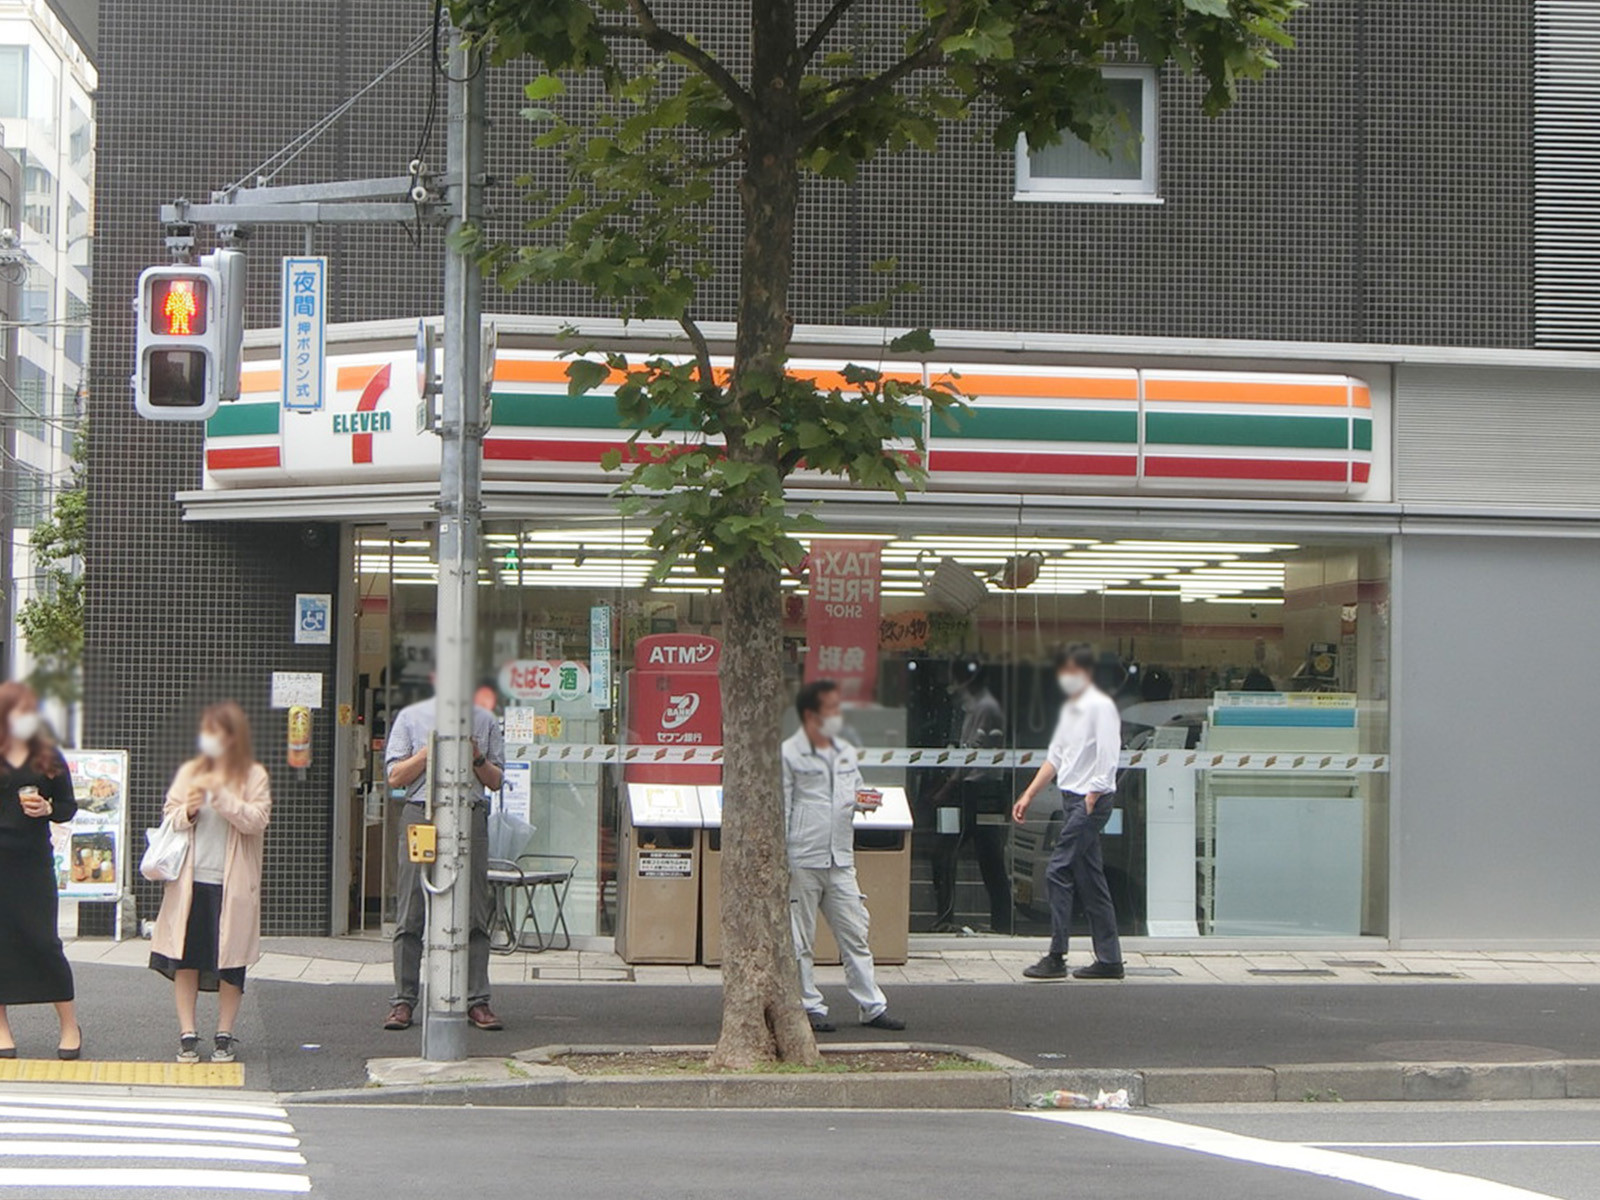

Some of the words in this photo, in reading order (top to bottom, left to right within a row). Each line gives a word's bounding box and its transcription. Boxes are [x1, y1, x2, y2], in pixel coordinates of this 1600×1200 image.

[293, 271, 316, 397] 夜間押ボタン式
[337, 363, 391, 463] 7
[649, 646, 696, 664] ATM
[510, 665, 551, 689] たばこ
[559, 667, 578, 690] 酒
